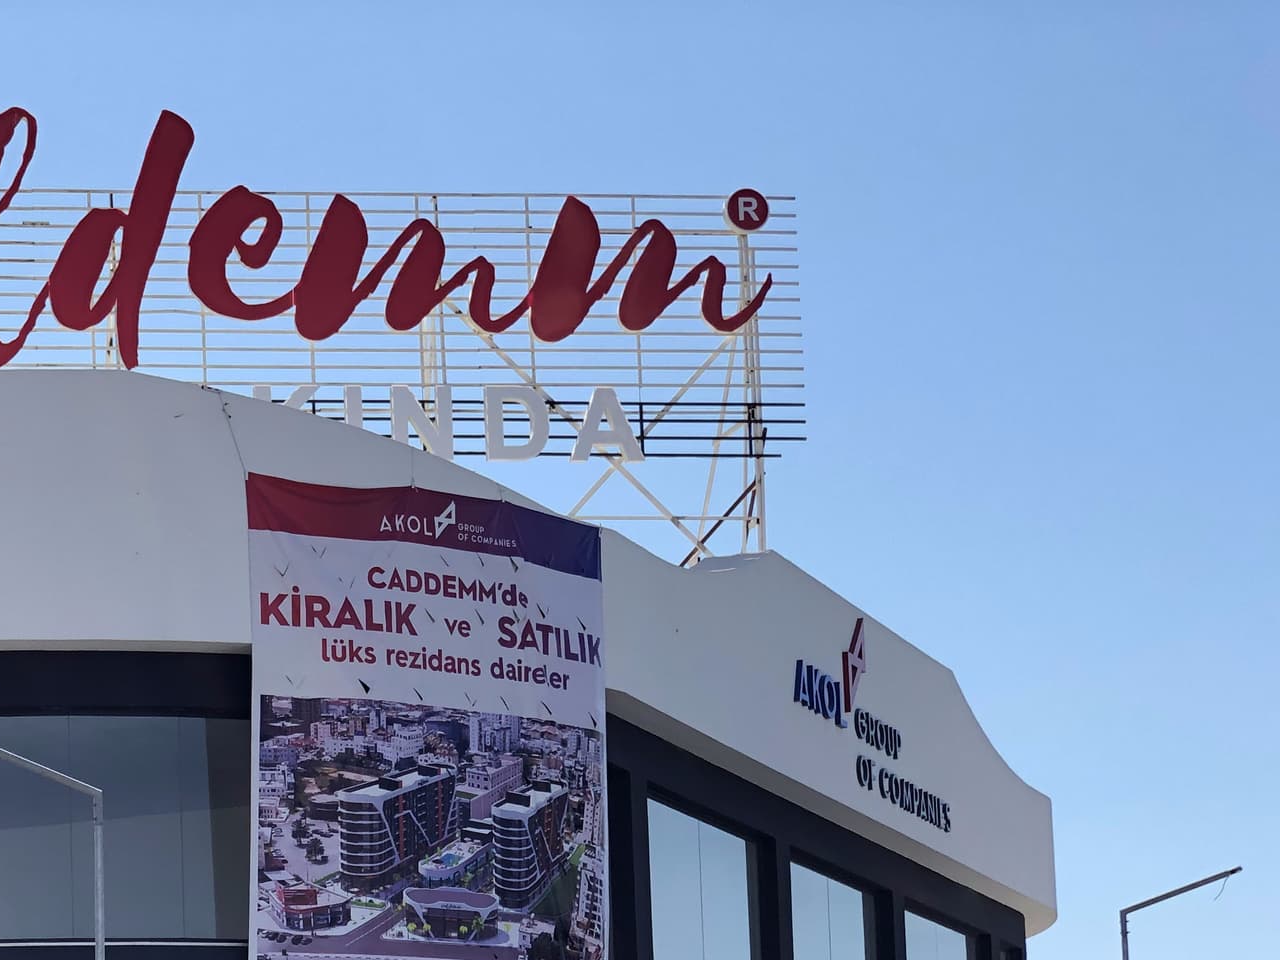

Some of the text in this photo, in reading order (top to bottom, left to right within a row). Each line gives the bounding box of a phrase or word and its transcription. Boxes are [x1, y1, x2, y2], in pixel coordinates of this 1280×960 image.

[379, 514, 433, 537] AKOL
[457, 523, 485, 534] GROUP
[457, 533, 518, 548] OF COMPANIES
[259, 585, 602, 669] KİRALIK ve SATILIK
[321, 638, 570, 691] lüks rezidans daireler
[793, 659, 849, 729] AKOL
[853, 707, 902, 760] GROUP
[855, 755, 952, 833] OF COMPANIES
